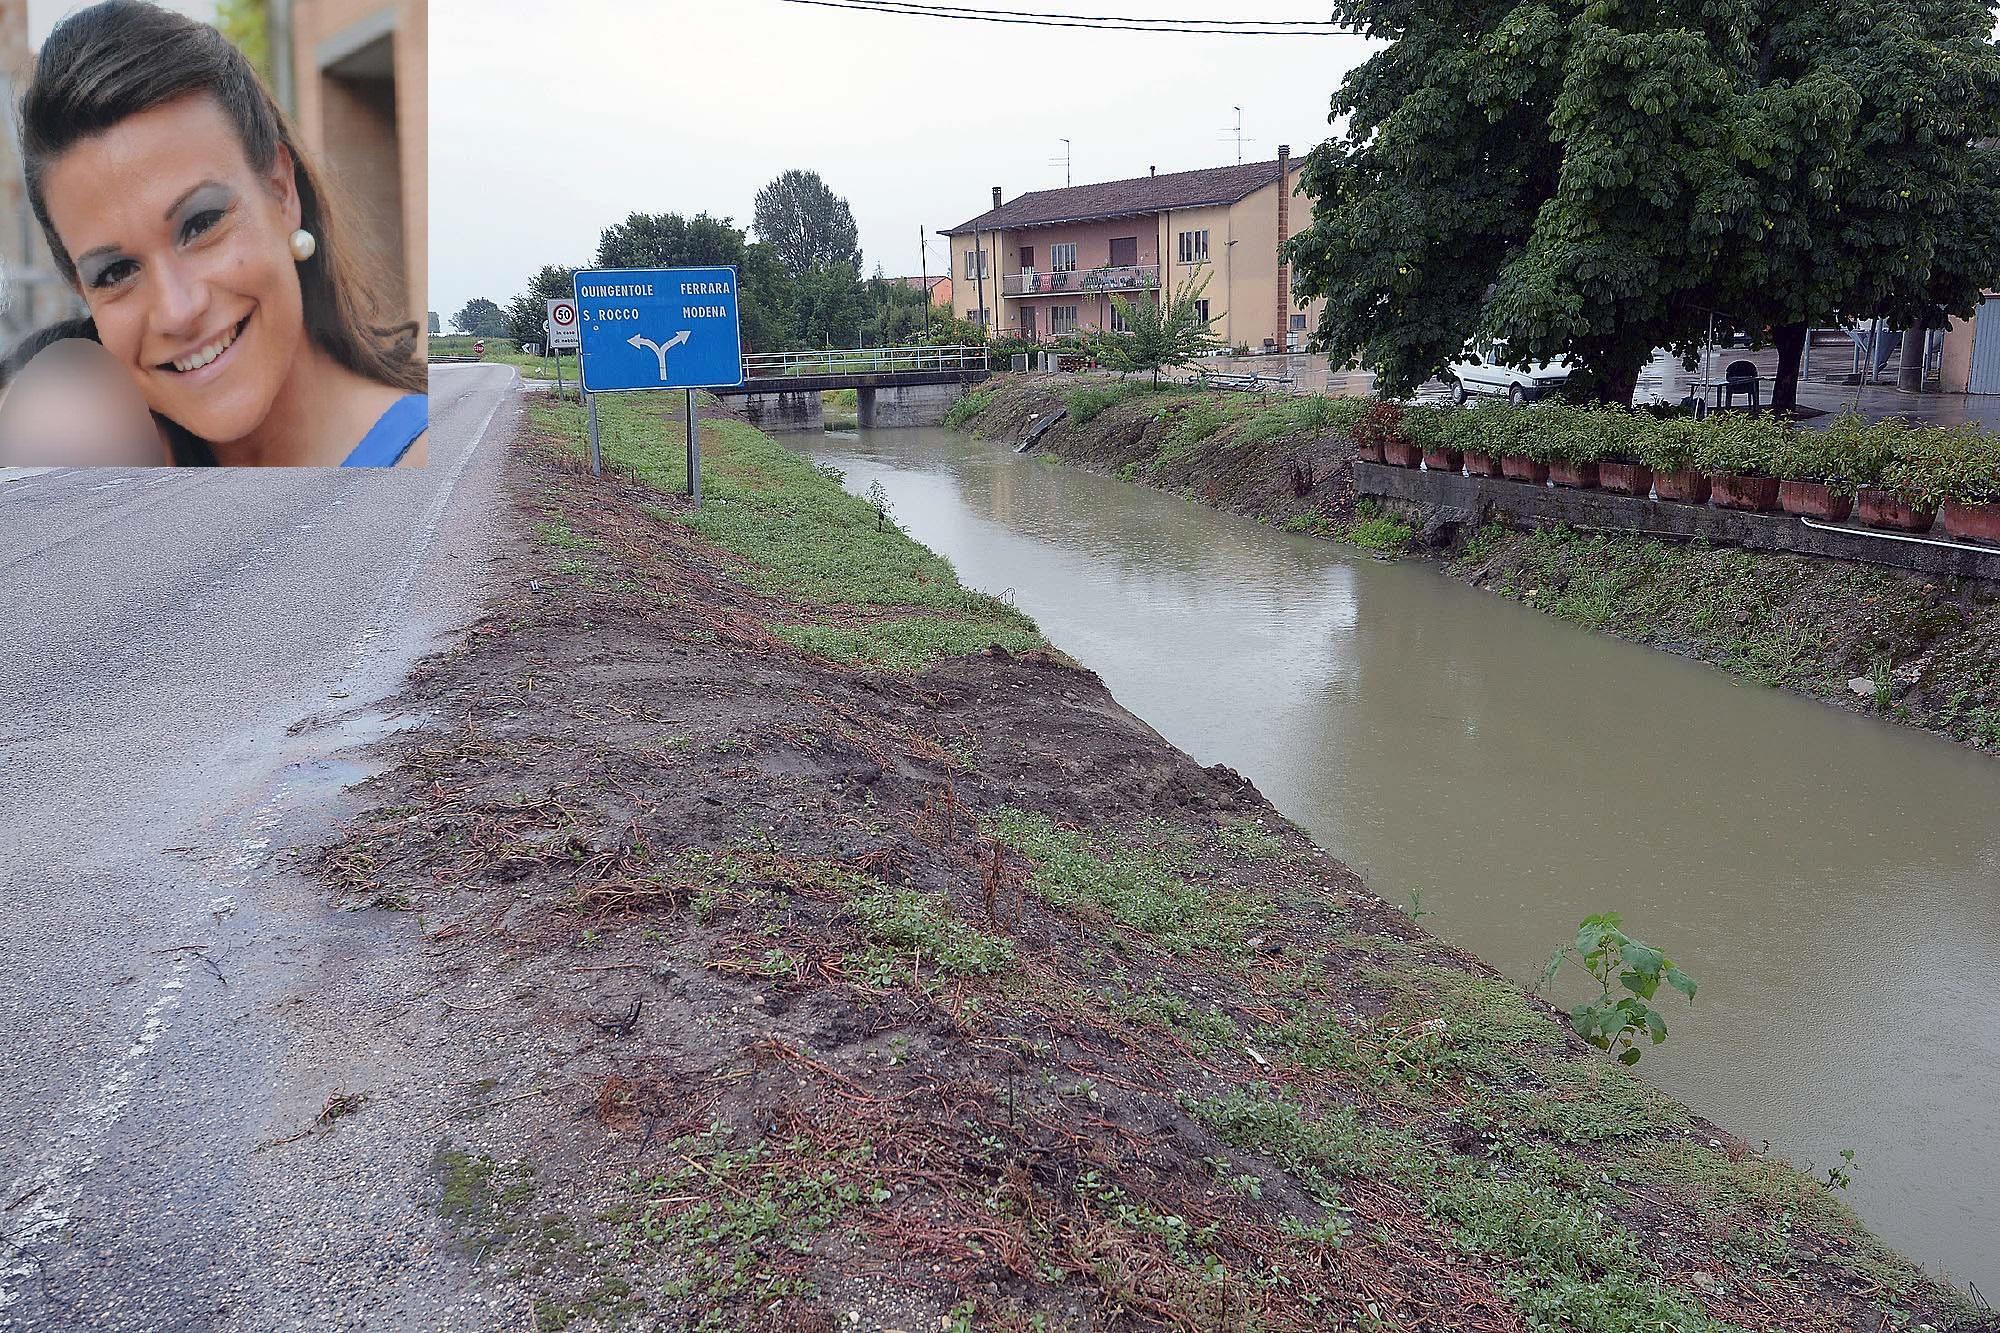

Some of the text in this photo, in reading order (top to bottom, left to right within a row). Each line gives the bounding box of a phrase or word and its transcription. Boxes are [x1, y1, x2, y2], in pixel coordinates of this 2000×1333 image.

[581, 285, 654, 297] QUINGENTOLE
[681, 283, 730, 295] FERRARA
[558, 310, 570, 319] 50
[599, 308, 639, 321] ROCCO
[682, 306, 727, 319] MODENA
